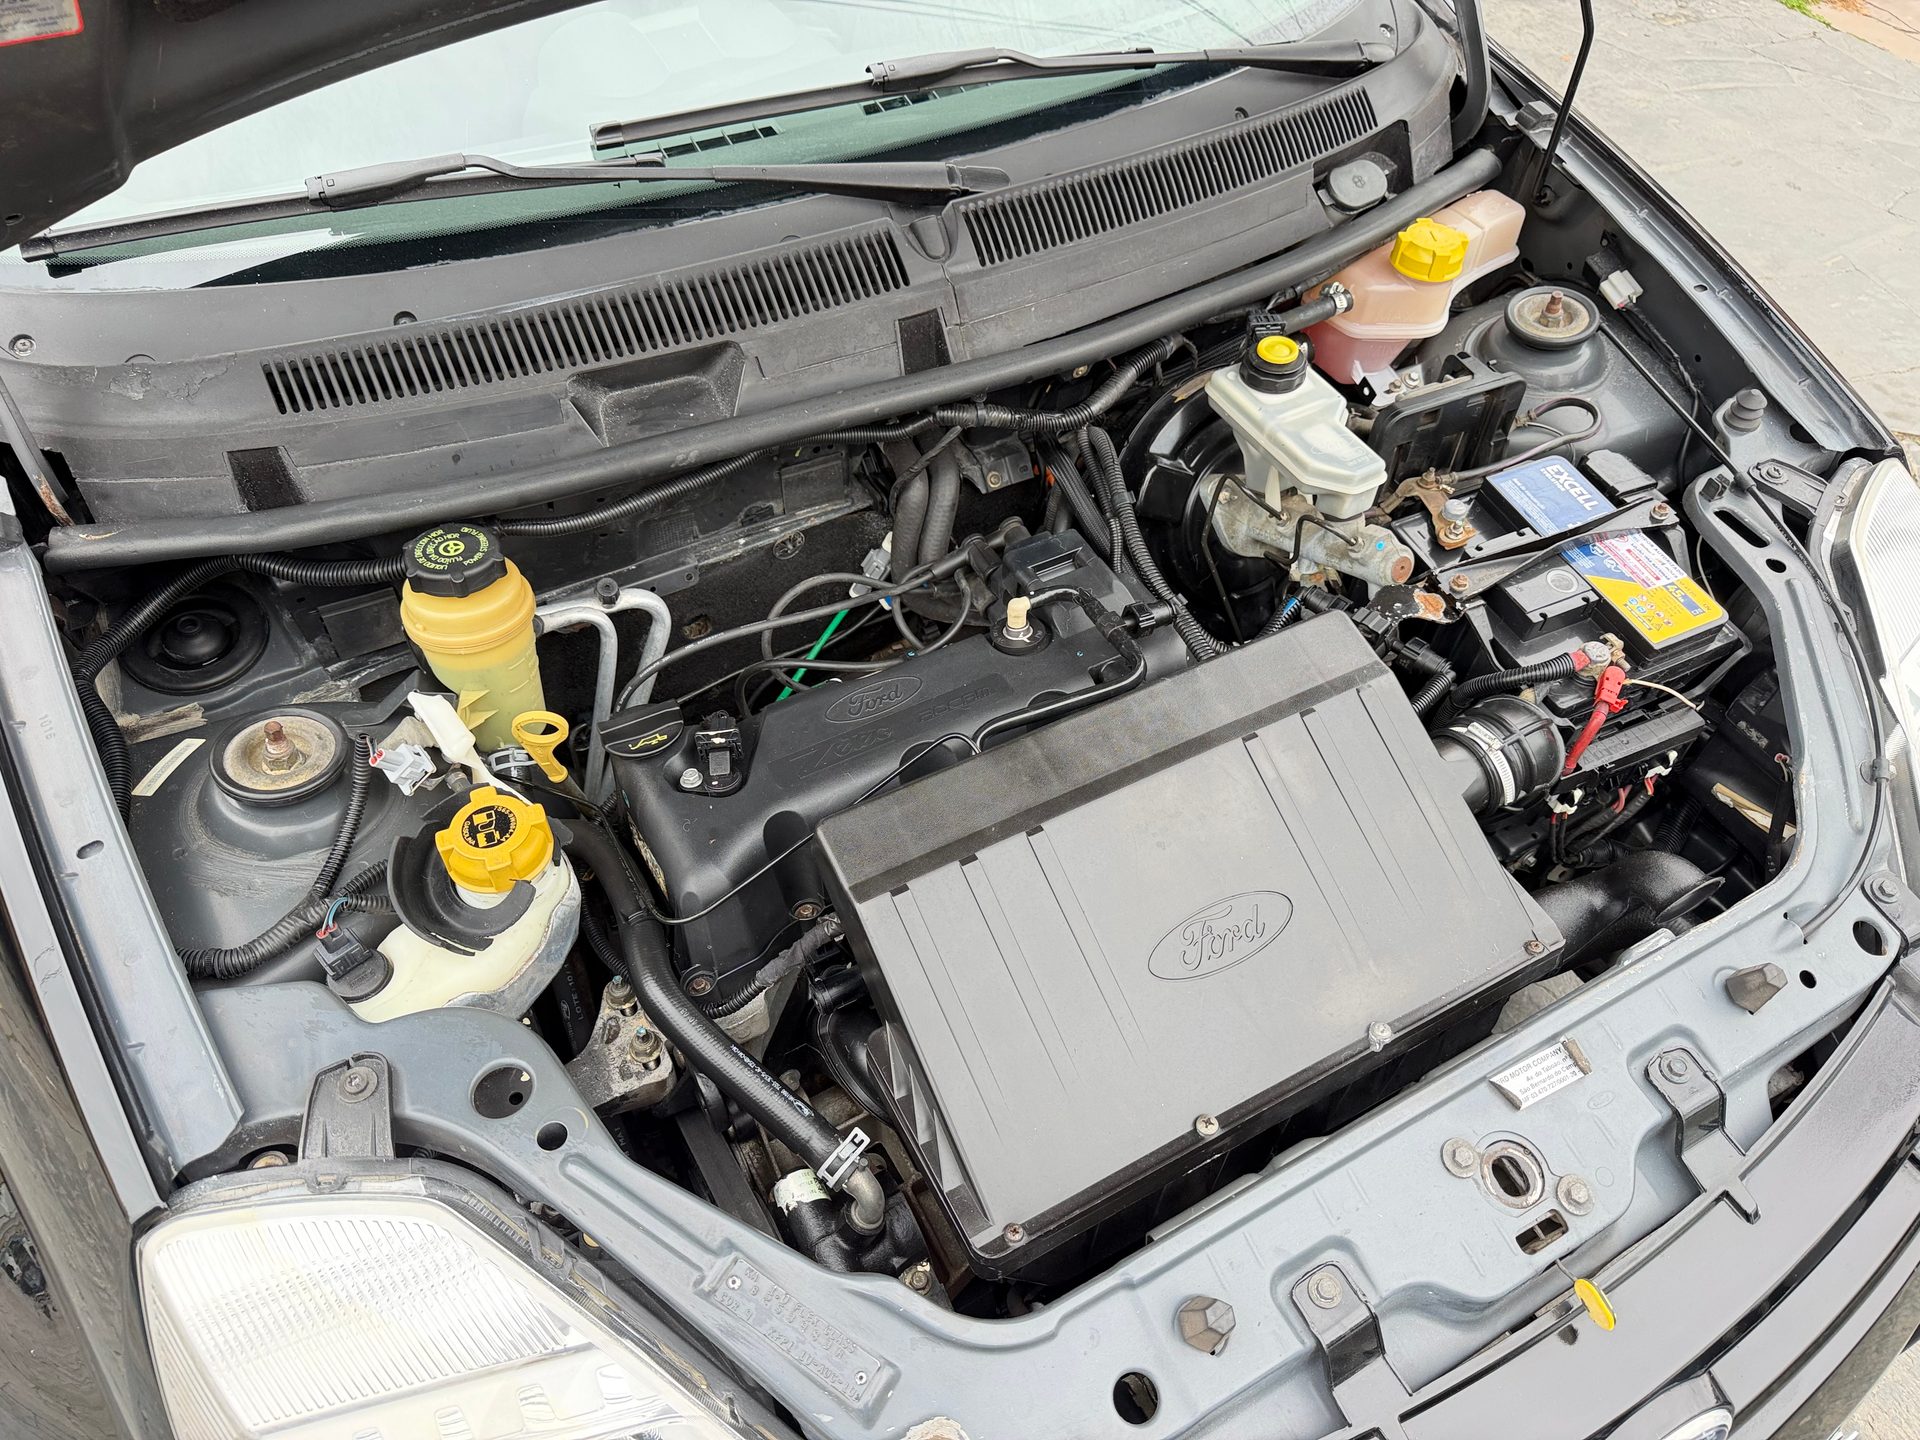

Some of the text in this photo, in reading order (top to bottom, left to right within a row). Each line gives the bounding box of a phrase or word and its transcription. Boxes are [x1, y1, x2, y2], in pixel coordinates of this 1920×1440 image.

[1546, 464, 1599, 511] EXCELL
[847, 684, 903, 717] Ford
[1180, 903, 1266, 971] Ford
[1509, 1063, 1532, 1080] MOTOR
[1532, 1046, 1562, 1067] COMPANY
[1530, 1074, 1554, 1090] Bernardo
[824, 1325, 857, 1354] CLASS
